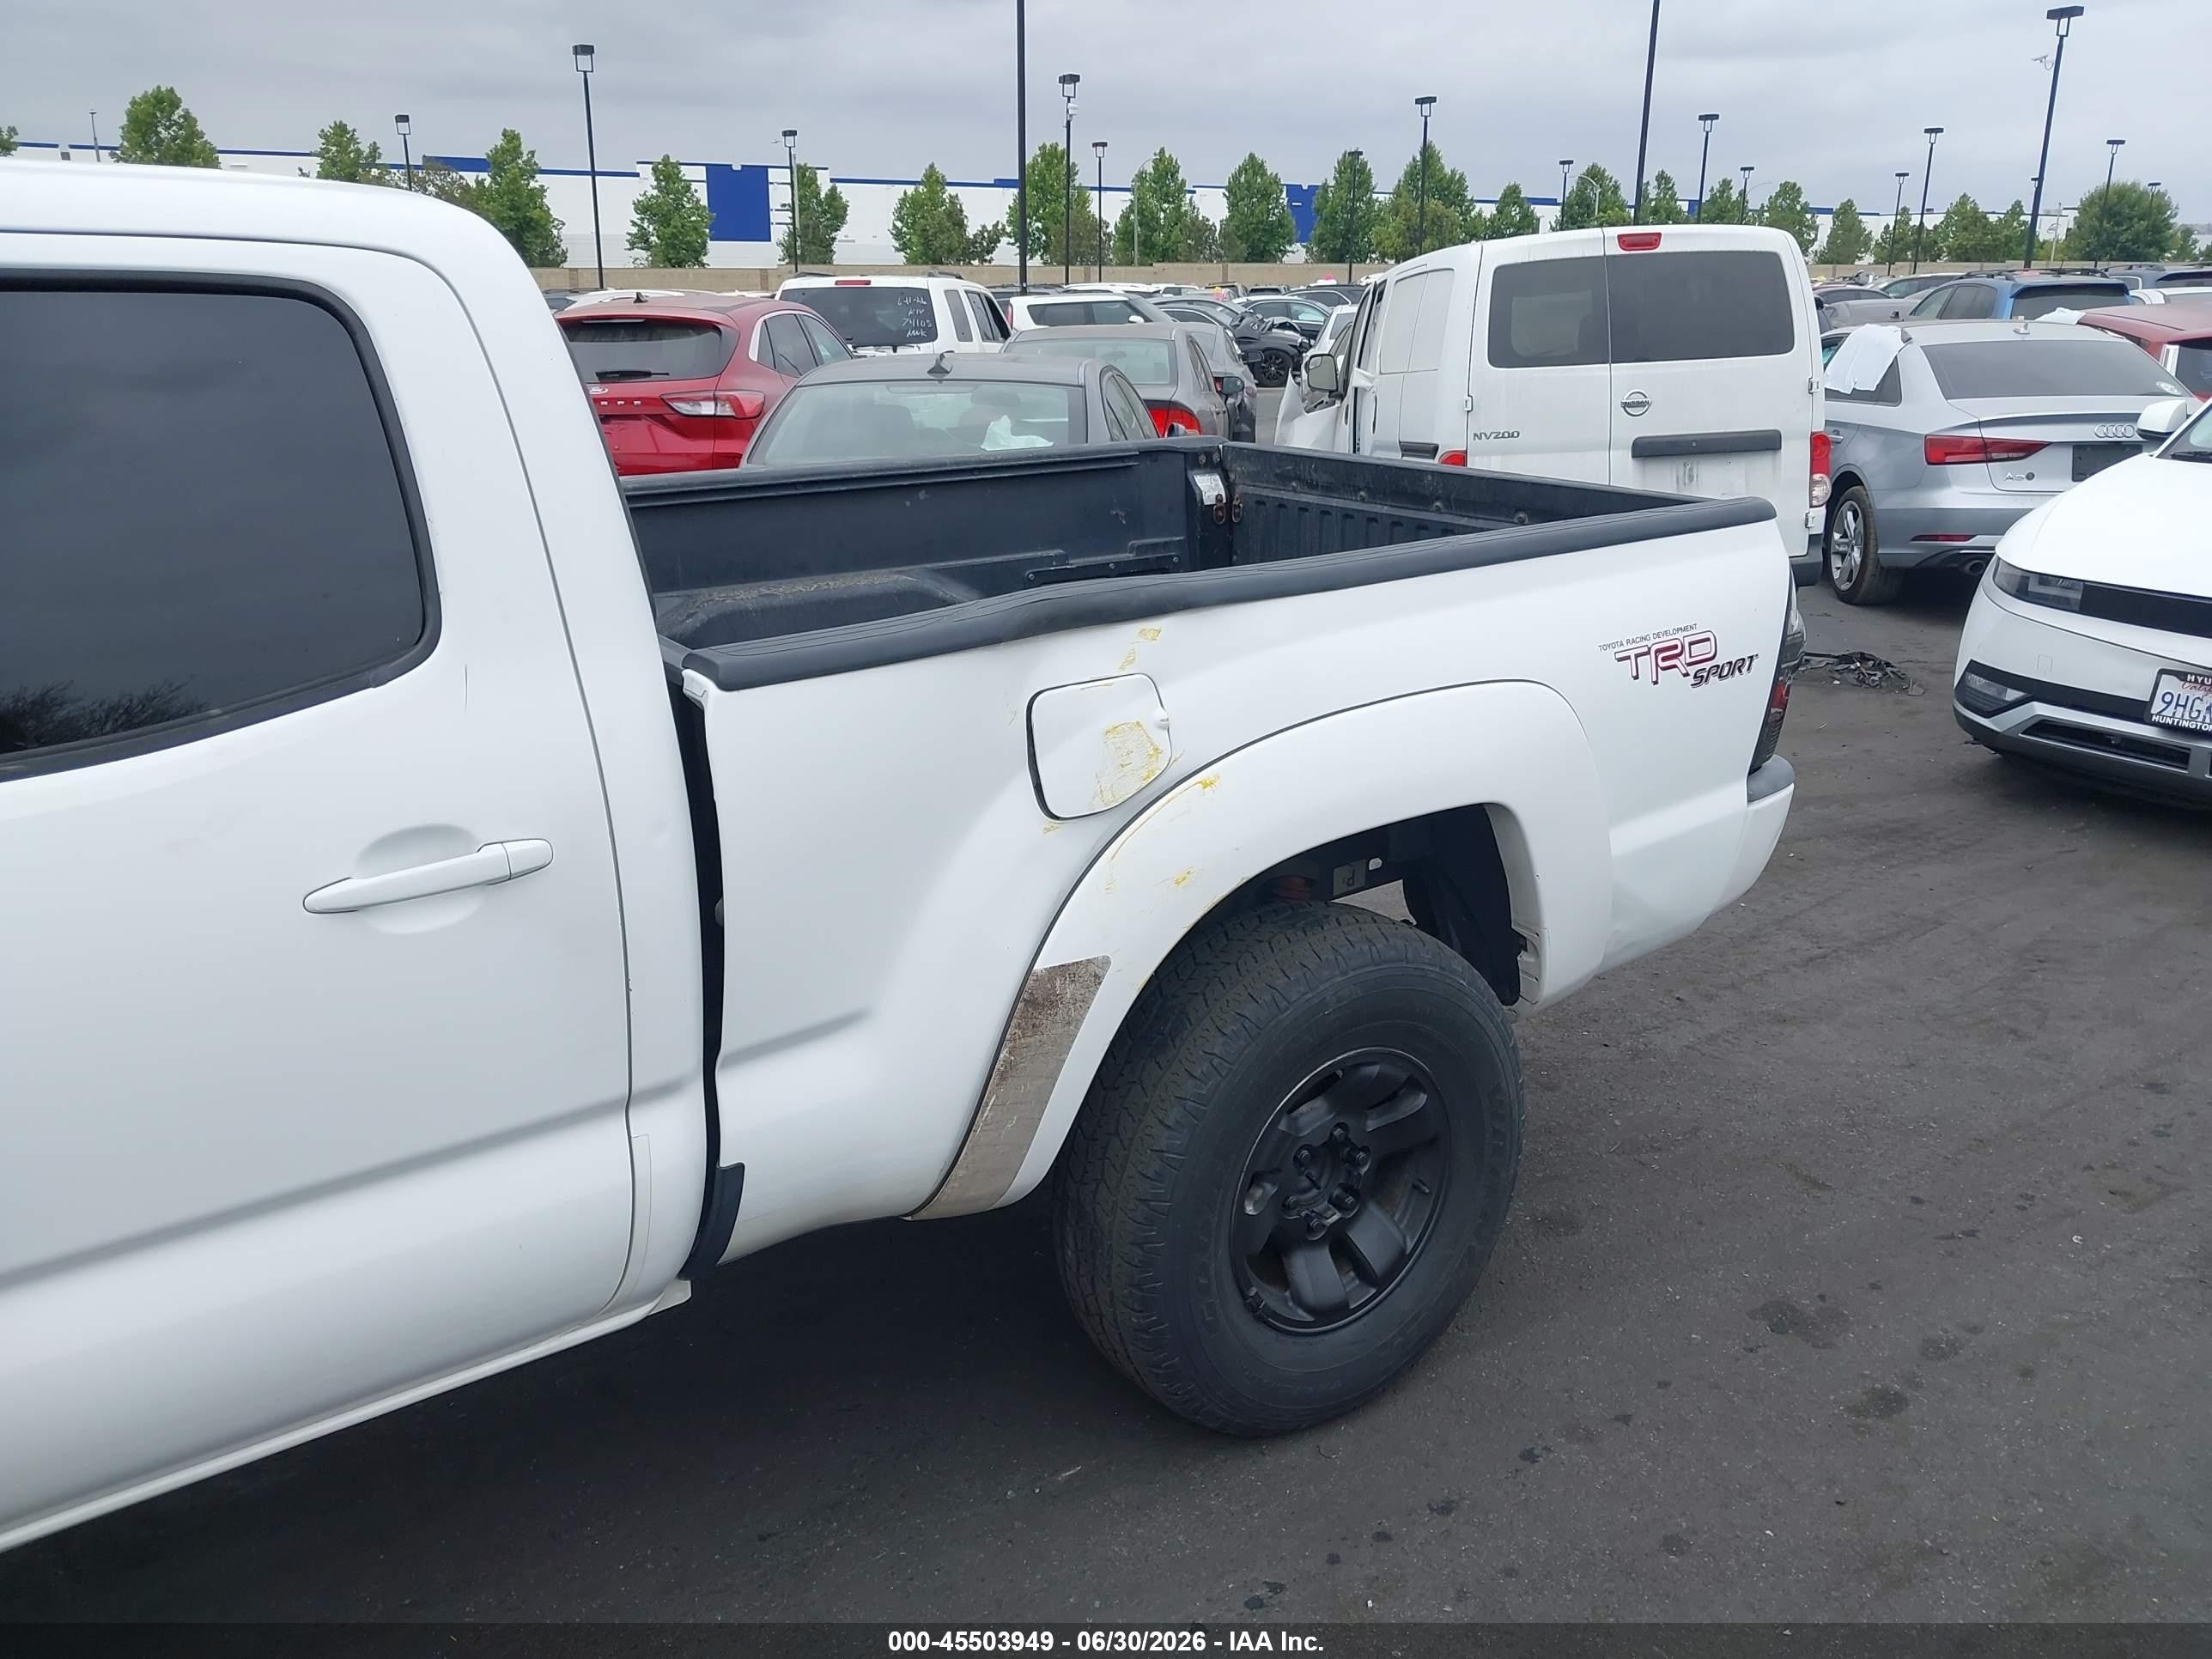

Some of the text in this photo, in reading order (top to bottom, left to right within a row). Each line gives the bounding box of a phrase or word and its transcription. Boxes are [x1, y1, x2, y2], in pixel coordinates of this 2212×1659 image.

[1473, 430, 1520, 441] NV200
[1598, 623, 1698, 652] TOYOTA RACING DEVELOPMENT
[1614, 630, 1717, 685] TRD
[1690, 653, 1758, 688] SPORT
